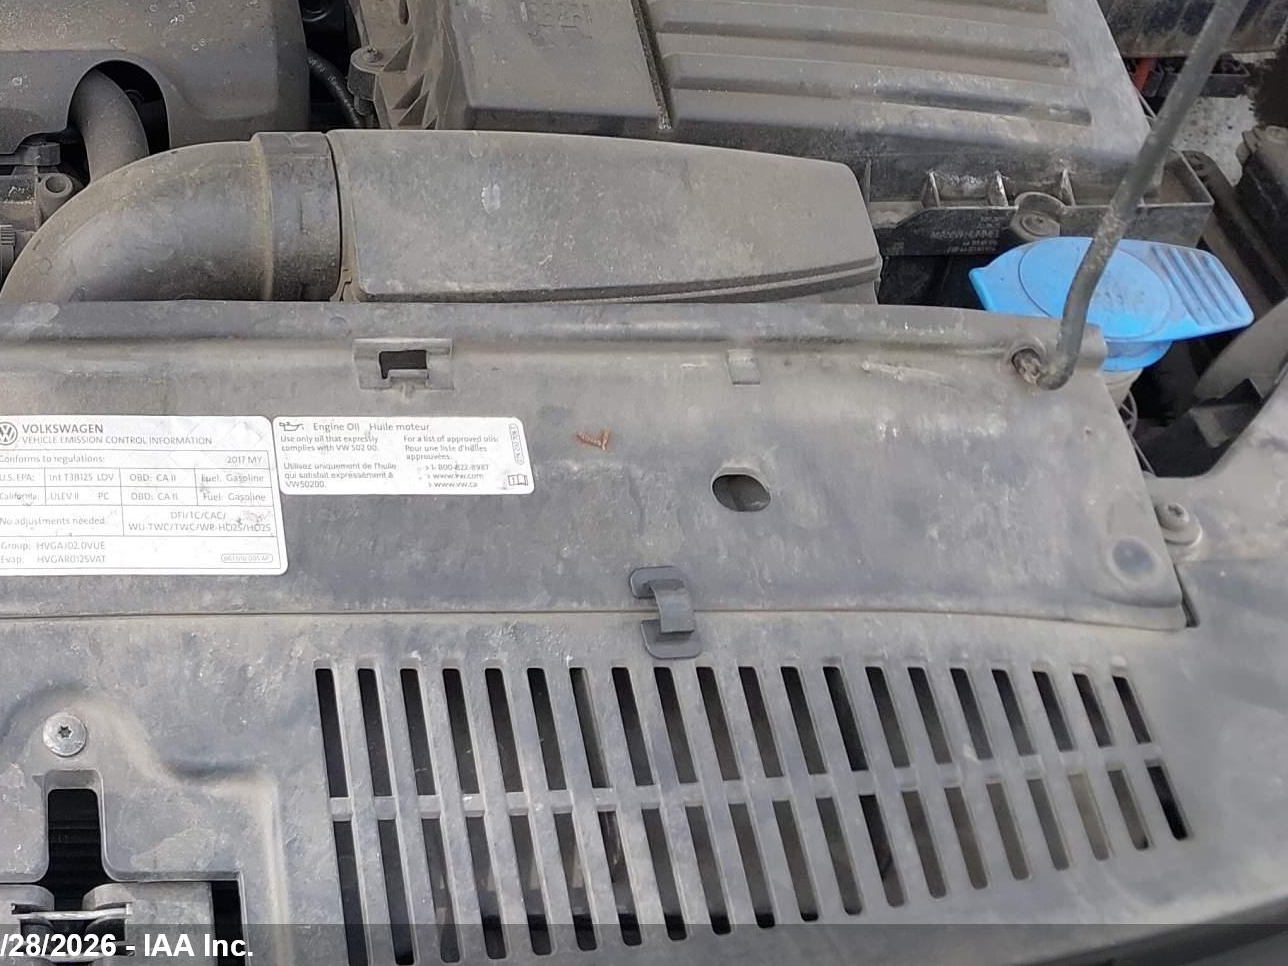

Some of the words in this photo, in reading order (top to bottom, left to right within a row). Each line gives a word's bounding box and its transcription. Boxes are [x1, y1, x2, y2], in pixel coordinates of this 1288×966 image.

[22, 424, 103, 434] VOLKSWAGEN
[313, 423, 344, 433] Engine
[346, 422, 360, 431] Oil
[369, 422, 393, 431] Huile
[22, 436, 58, 444] VEHICLE
[60, 436, 103, 444] EMISSION
[105, 436, 146, 444] CONTROL
[149, 436, 212, 444] INFORMATION
[296, 436, 312, 444] only
[42, 455, 52, 463] to
[227, 456, 246, 464] 2017
[248, 456, 262, 464] MY
[96, 473, 114, 481] LDV
[226, 474, 264, 483] Gasoline
[98, 492, 109, 500] PC
[157, 492, 170, 500] CA
[227, 492, 266, 501] Gasoline
[14, 517, 70, 528] adjustments
